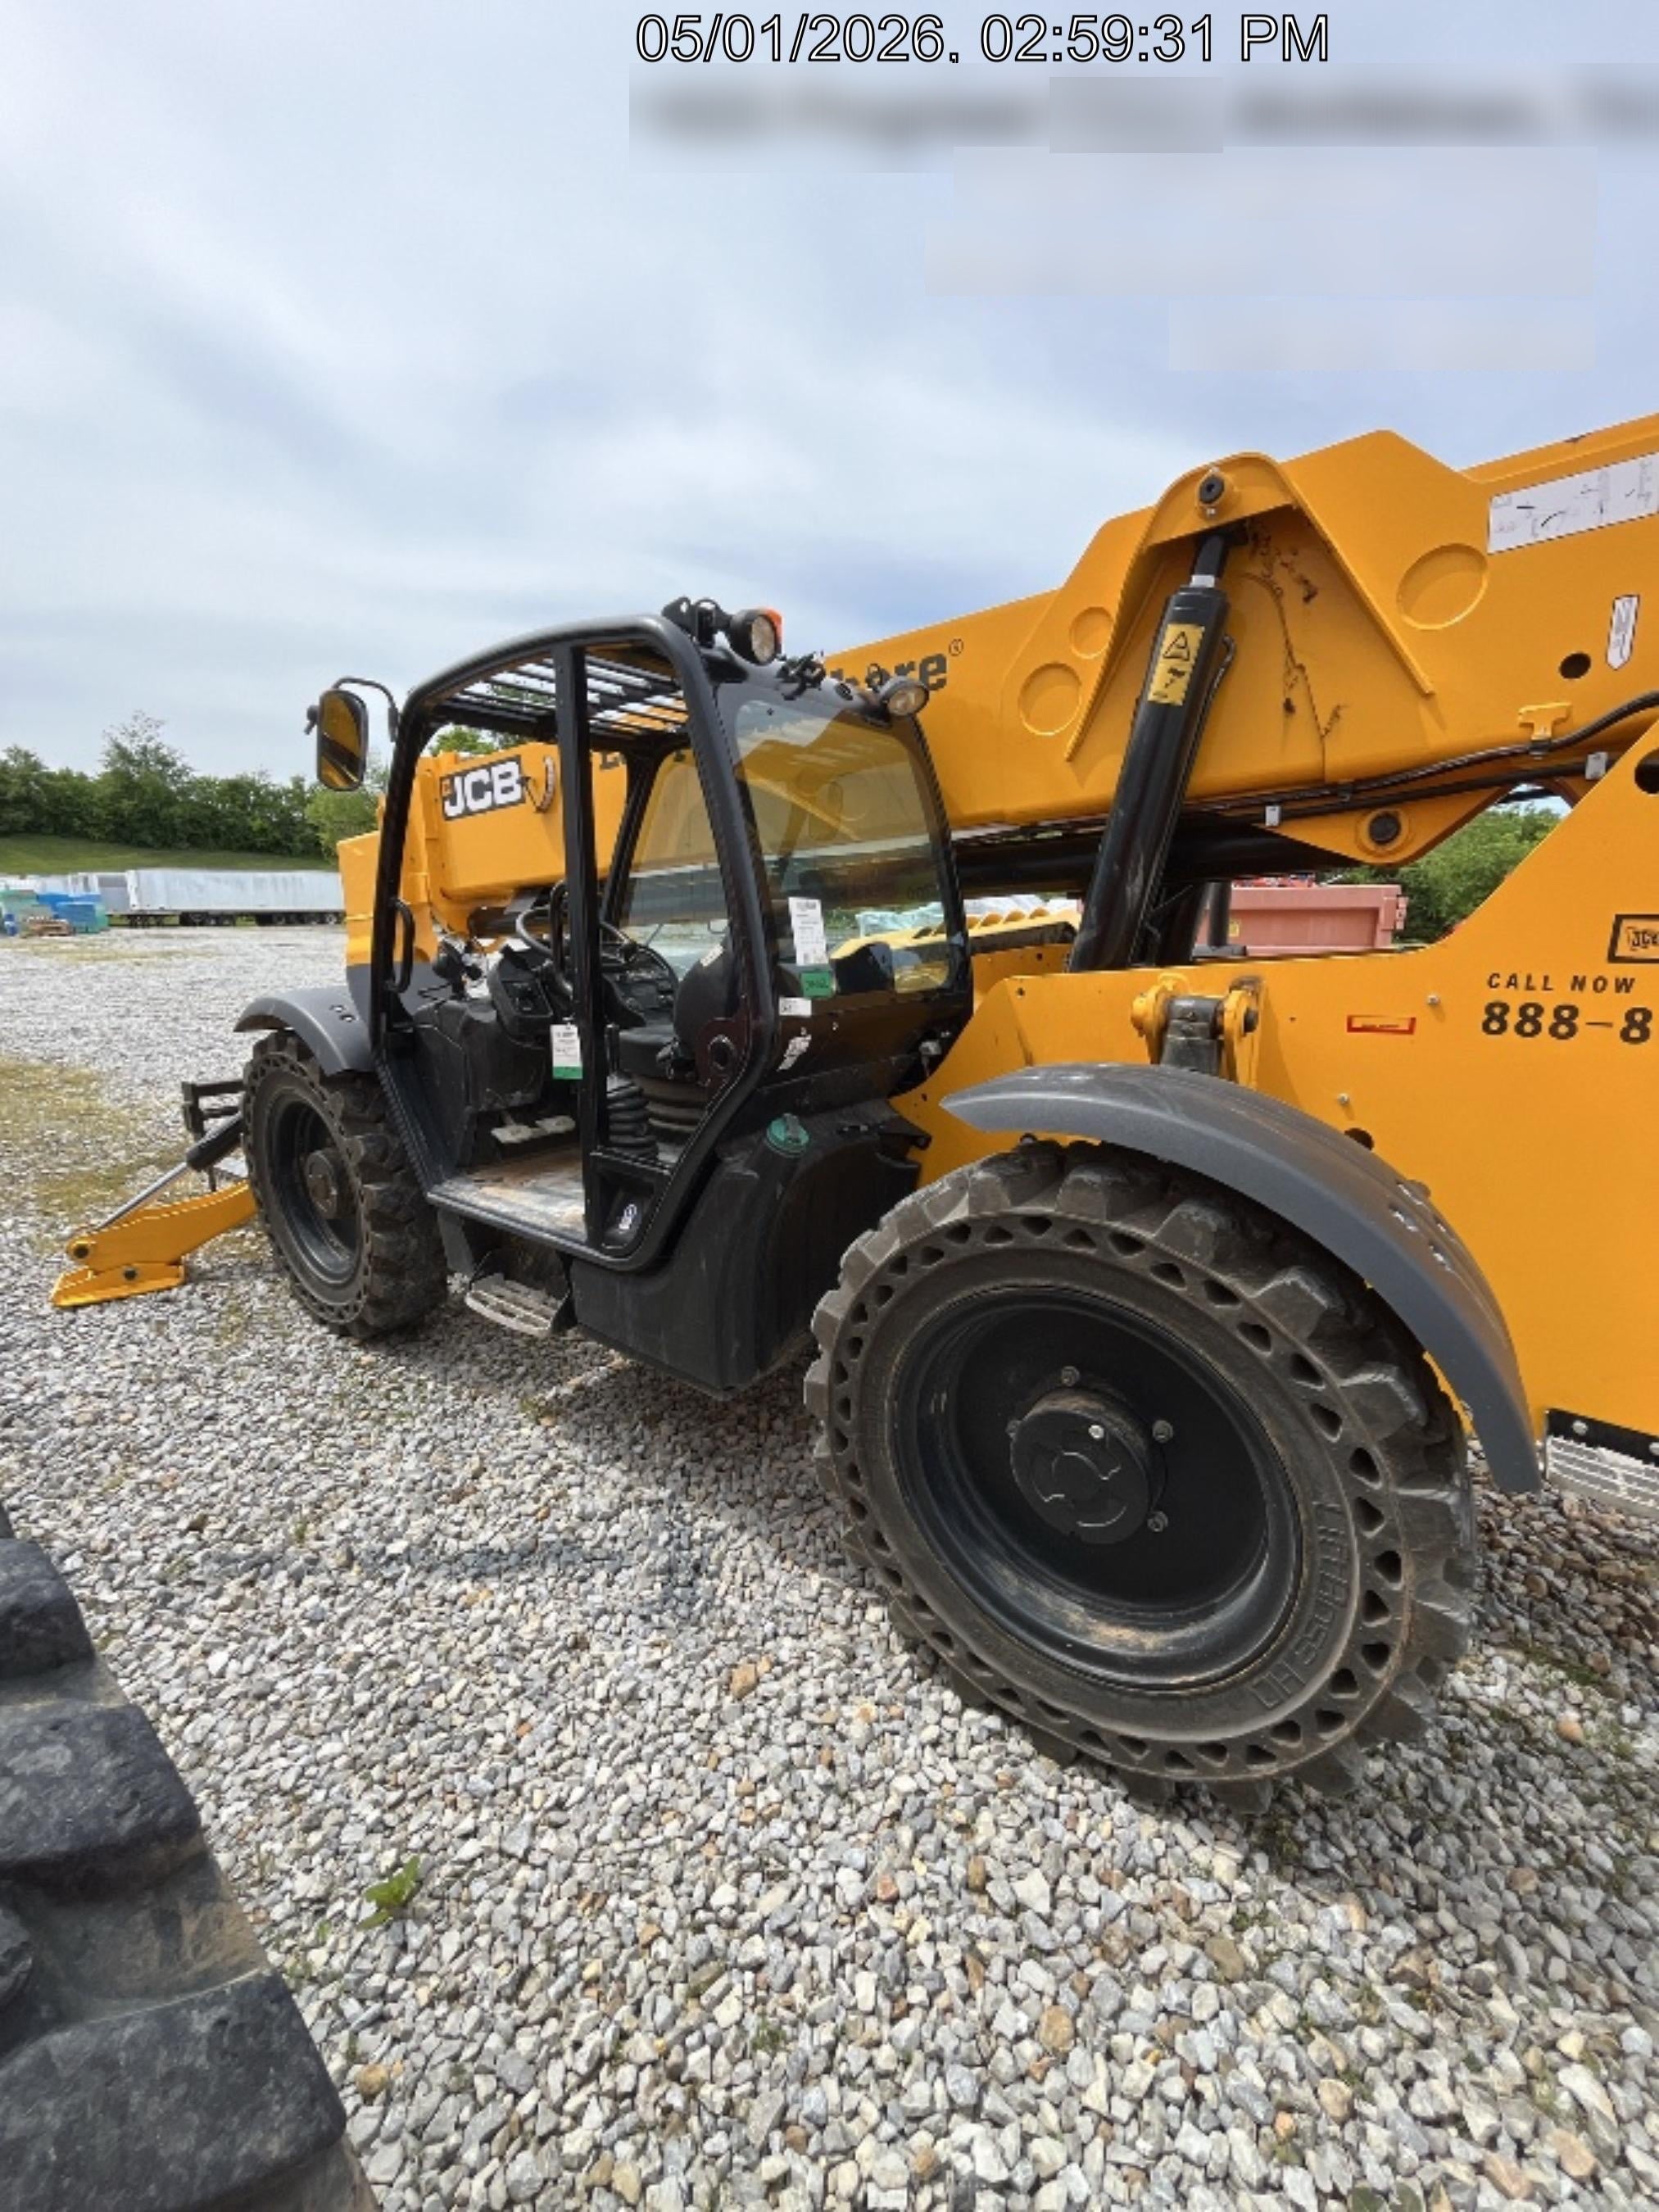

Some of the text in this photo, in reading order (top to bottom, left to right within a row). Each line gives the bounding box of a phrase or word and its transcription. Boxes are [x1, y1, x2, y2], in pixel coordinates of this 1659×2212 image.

[443, 759, 523, 818] JCB
[1487, 972, 1635, 994] CALL NOW
[1248, 1661, 1305, 1710] HD
